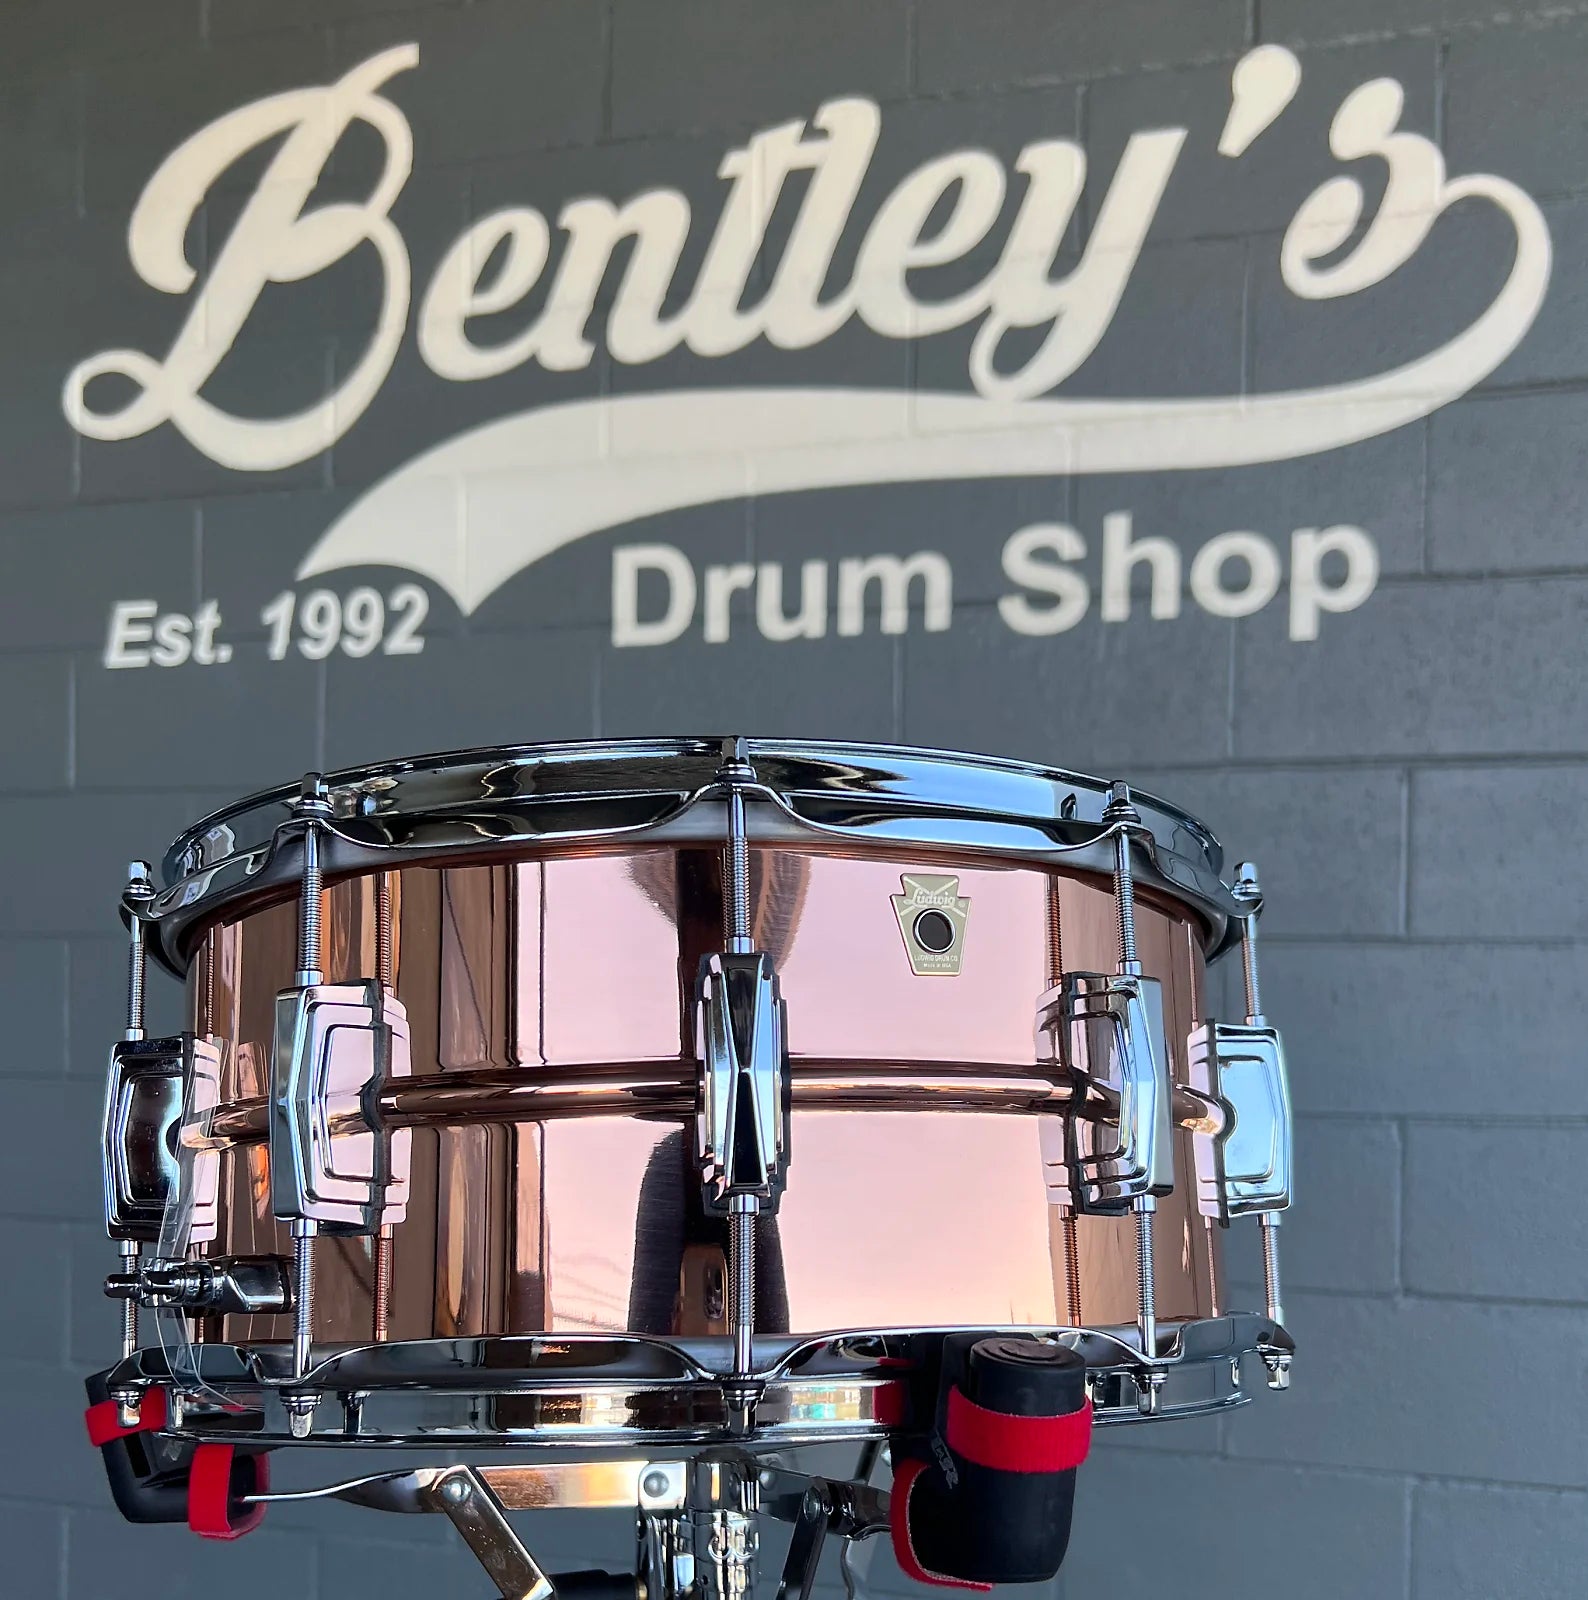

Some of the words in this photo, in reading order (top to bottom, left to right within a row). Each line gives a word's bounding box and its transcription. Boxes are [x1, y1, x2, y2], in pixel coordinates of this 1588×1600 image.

[62, 42, 1552, 471] Bentley's
[104, 599, 232, 669] Est.
[261, 586, 429, 660] 1992
[611, 544, 952, 648] Drum
[998, 512, 1379, 641] Shop
[903, 887, 956, 909] Ludwig
